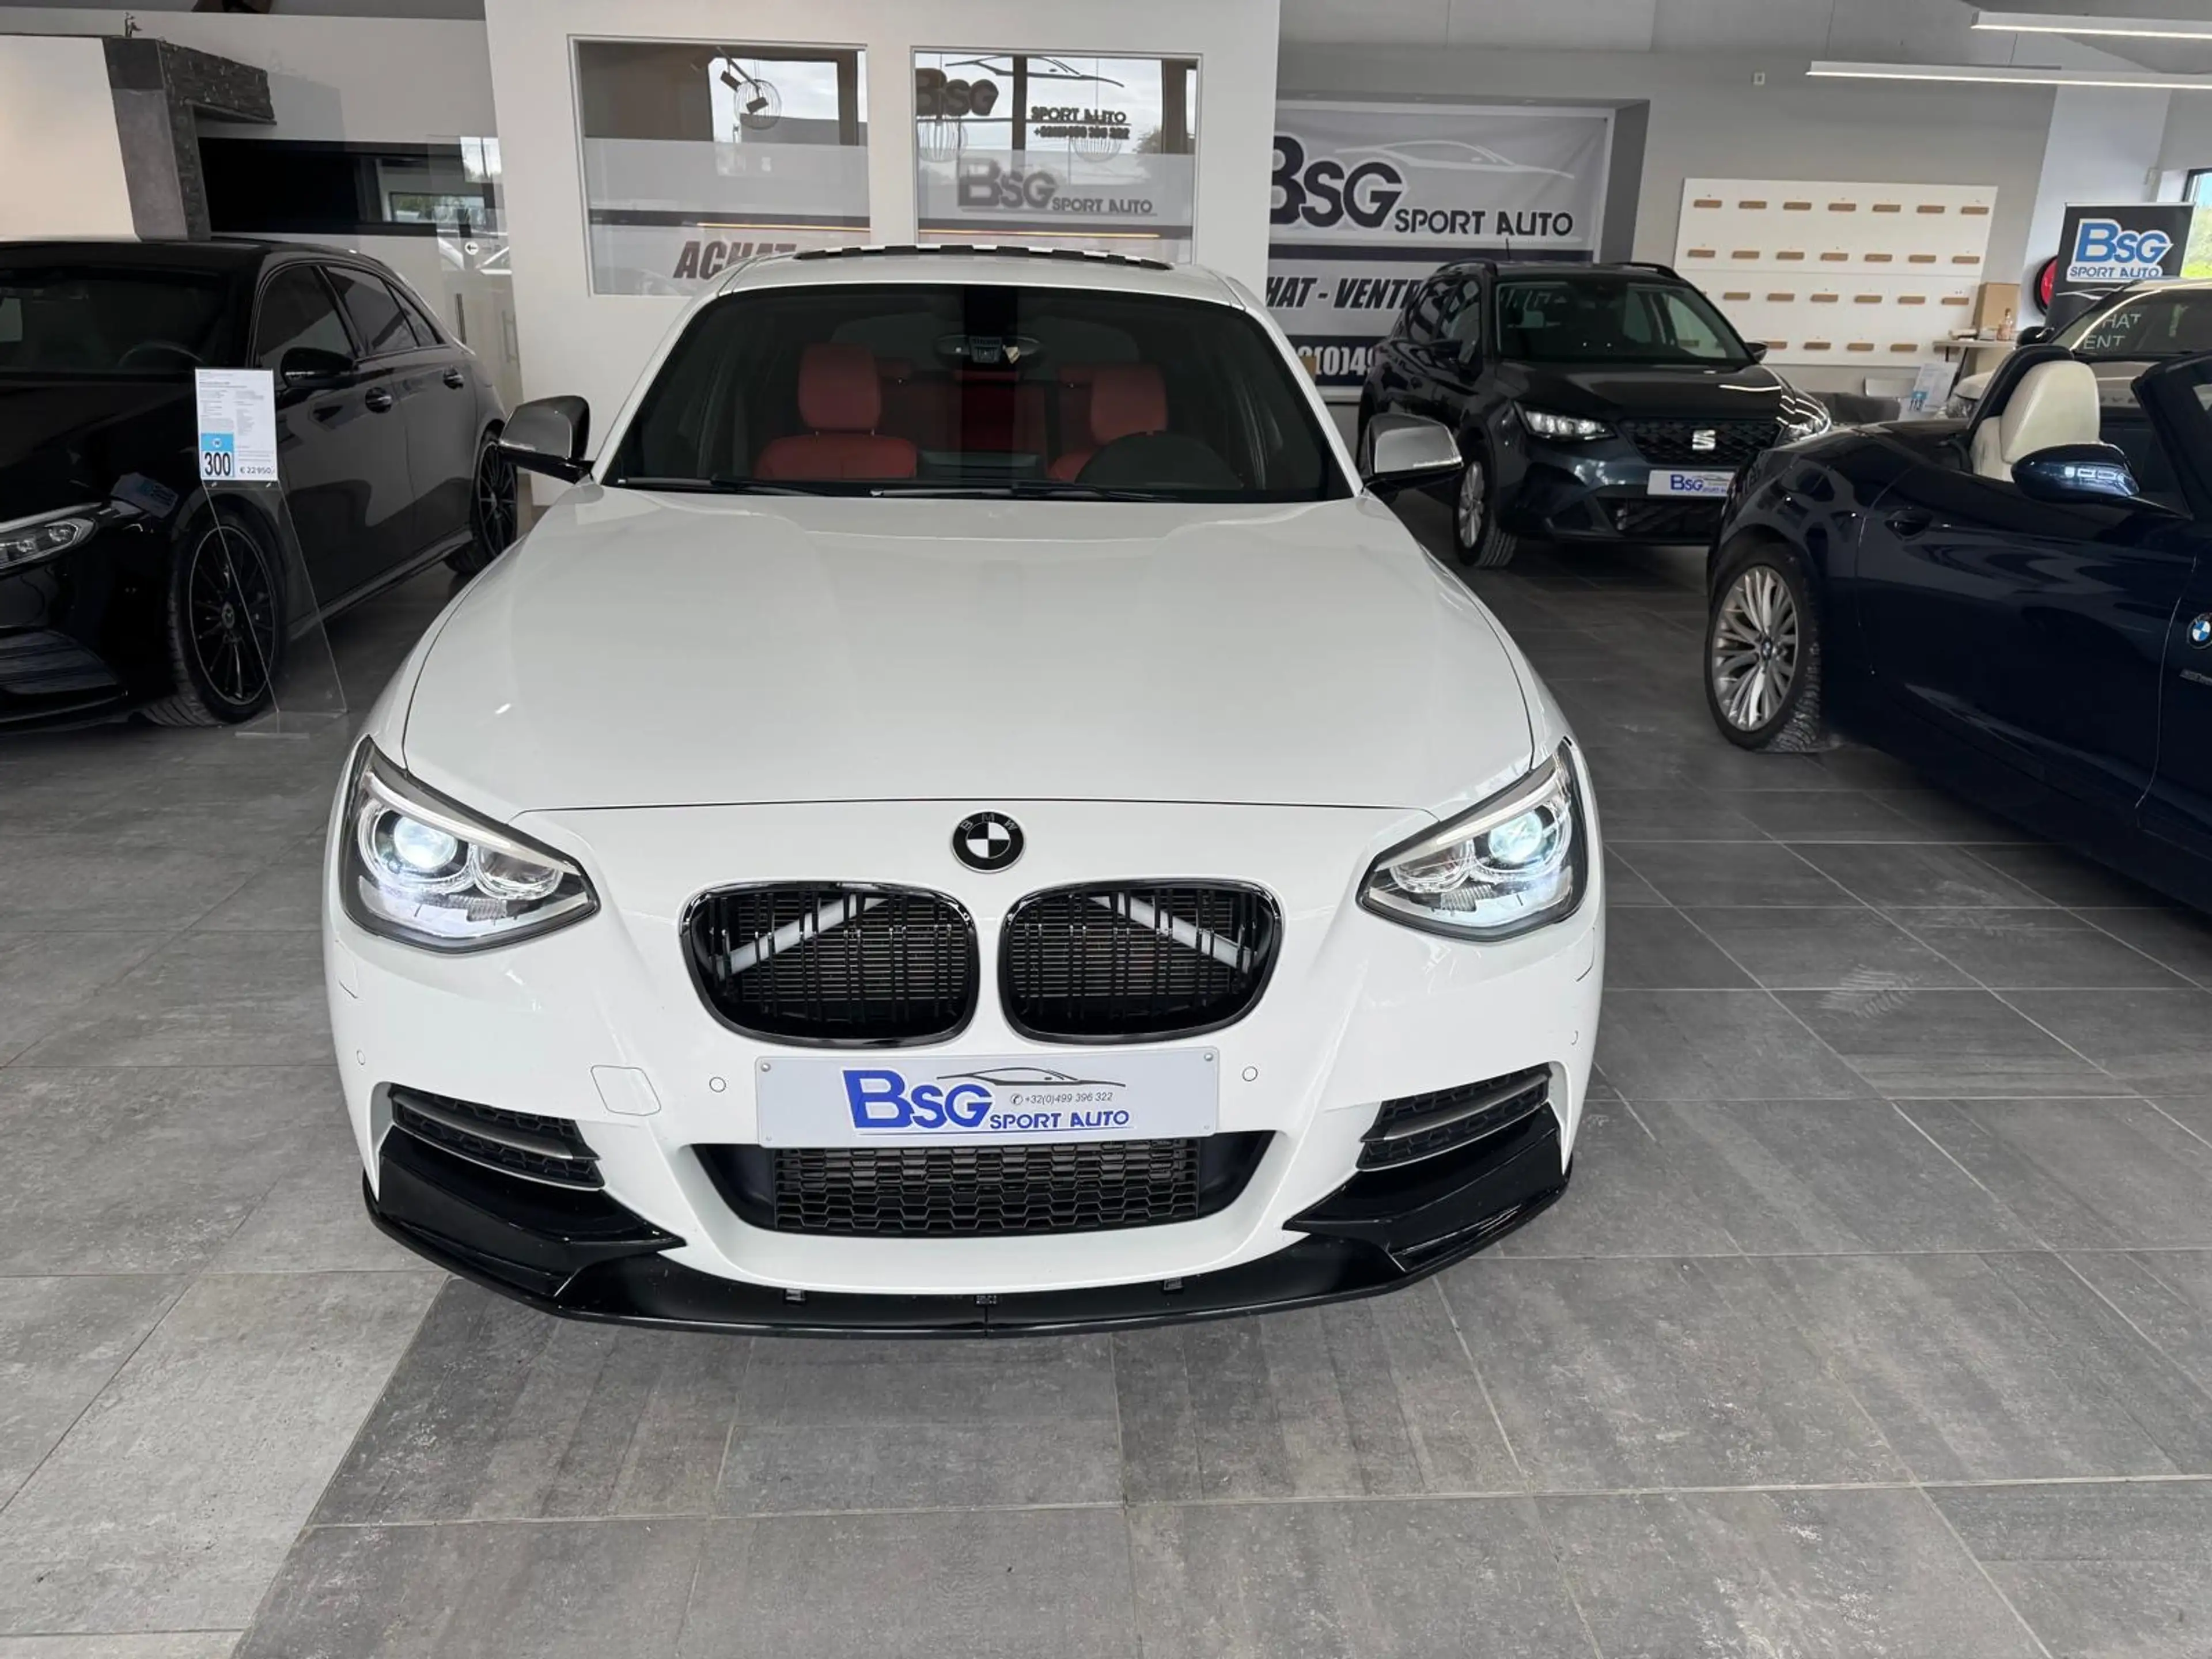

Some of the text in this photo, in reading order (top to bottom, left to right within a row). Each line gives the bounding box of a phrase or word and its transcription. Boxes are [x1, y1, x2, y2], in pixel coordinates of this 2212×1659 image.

[1031, 106, 1080, 121] SPORT
[957, 158, 1153, 214] BSG SPORT AUTO
[1270, 135, 1574, 237] BSG SPORT AUTO
[2075, 222, 2168, 264] BSG
[2070, 266, 2159, 278] SPORT AUTO
[204, 452, 231, 476] 300
[842, 1069, 1130, 1130] BSG SPORT AUTO
